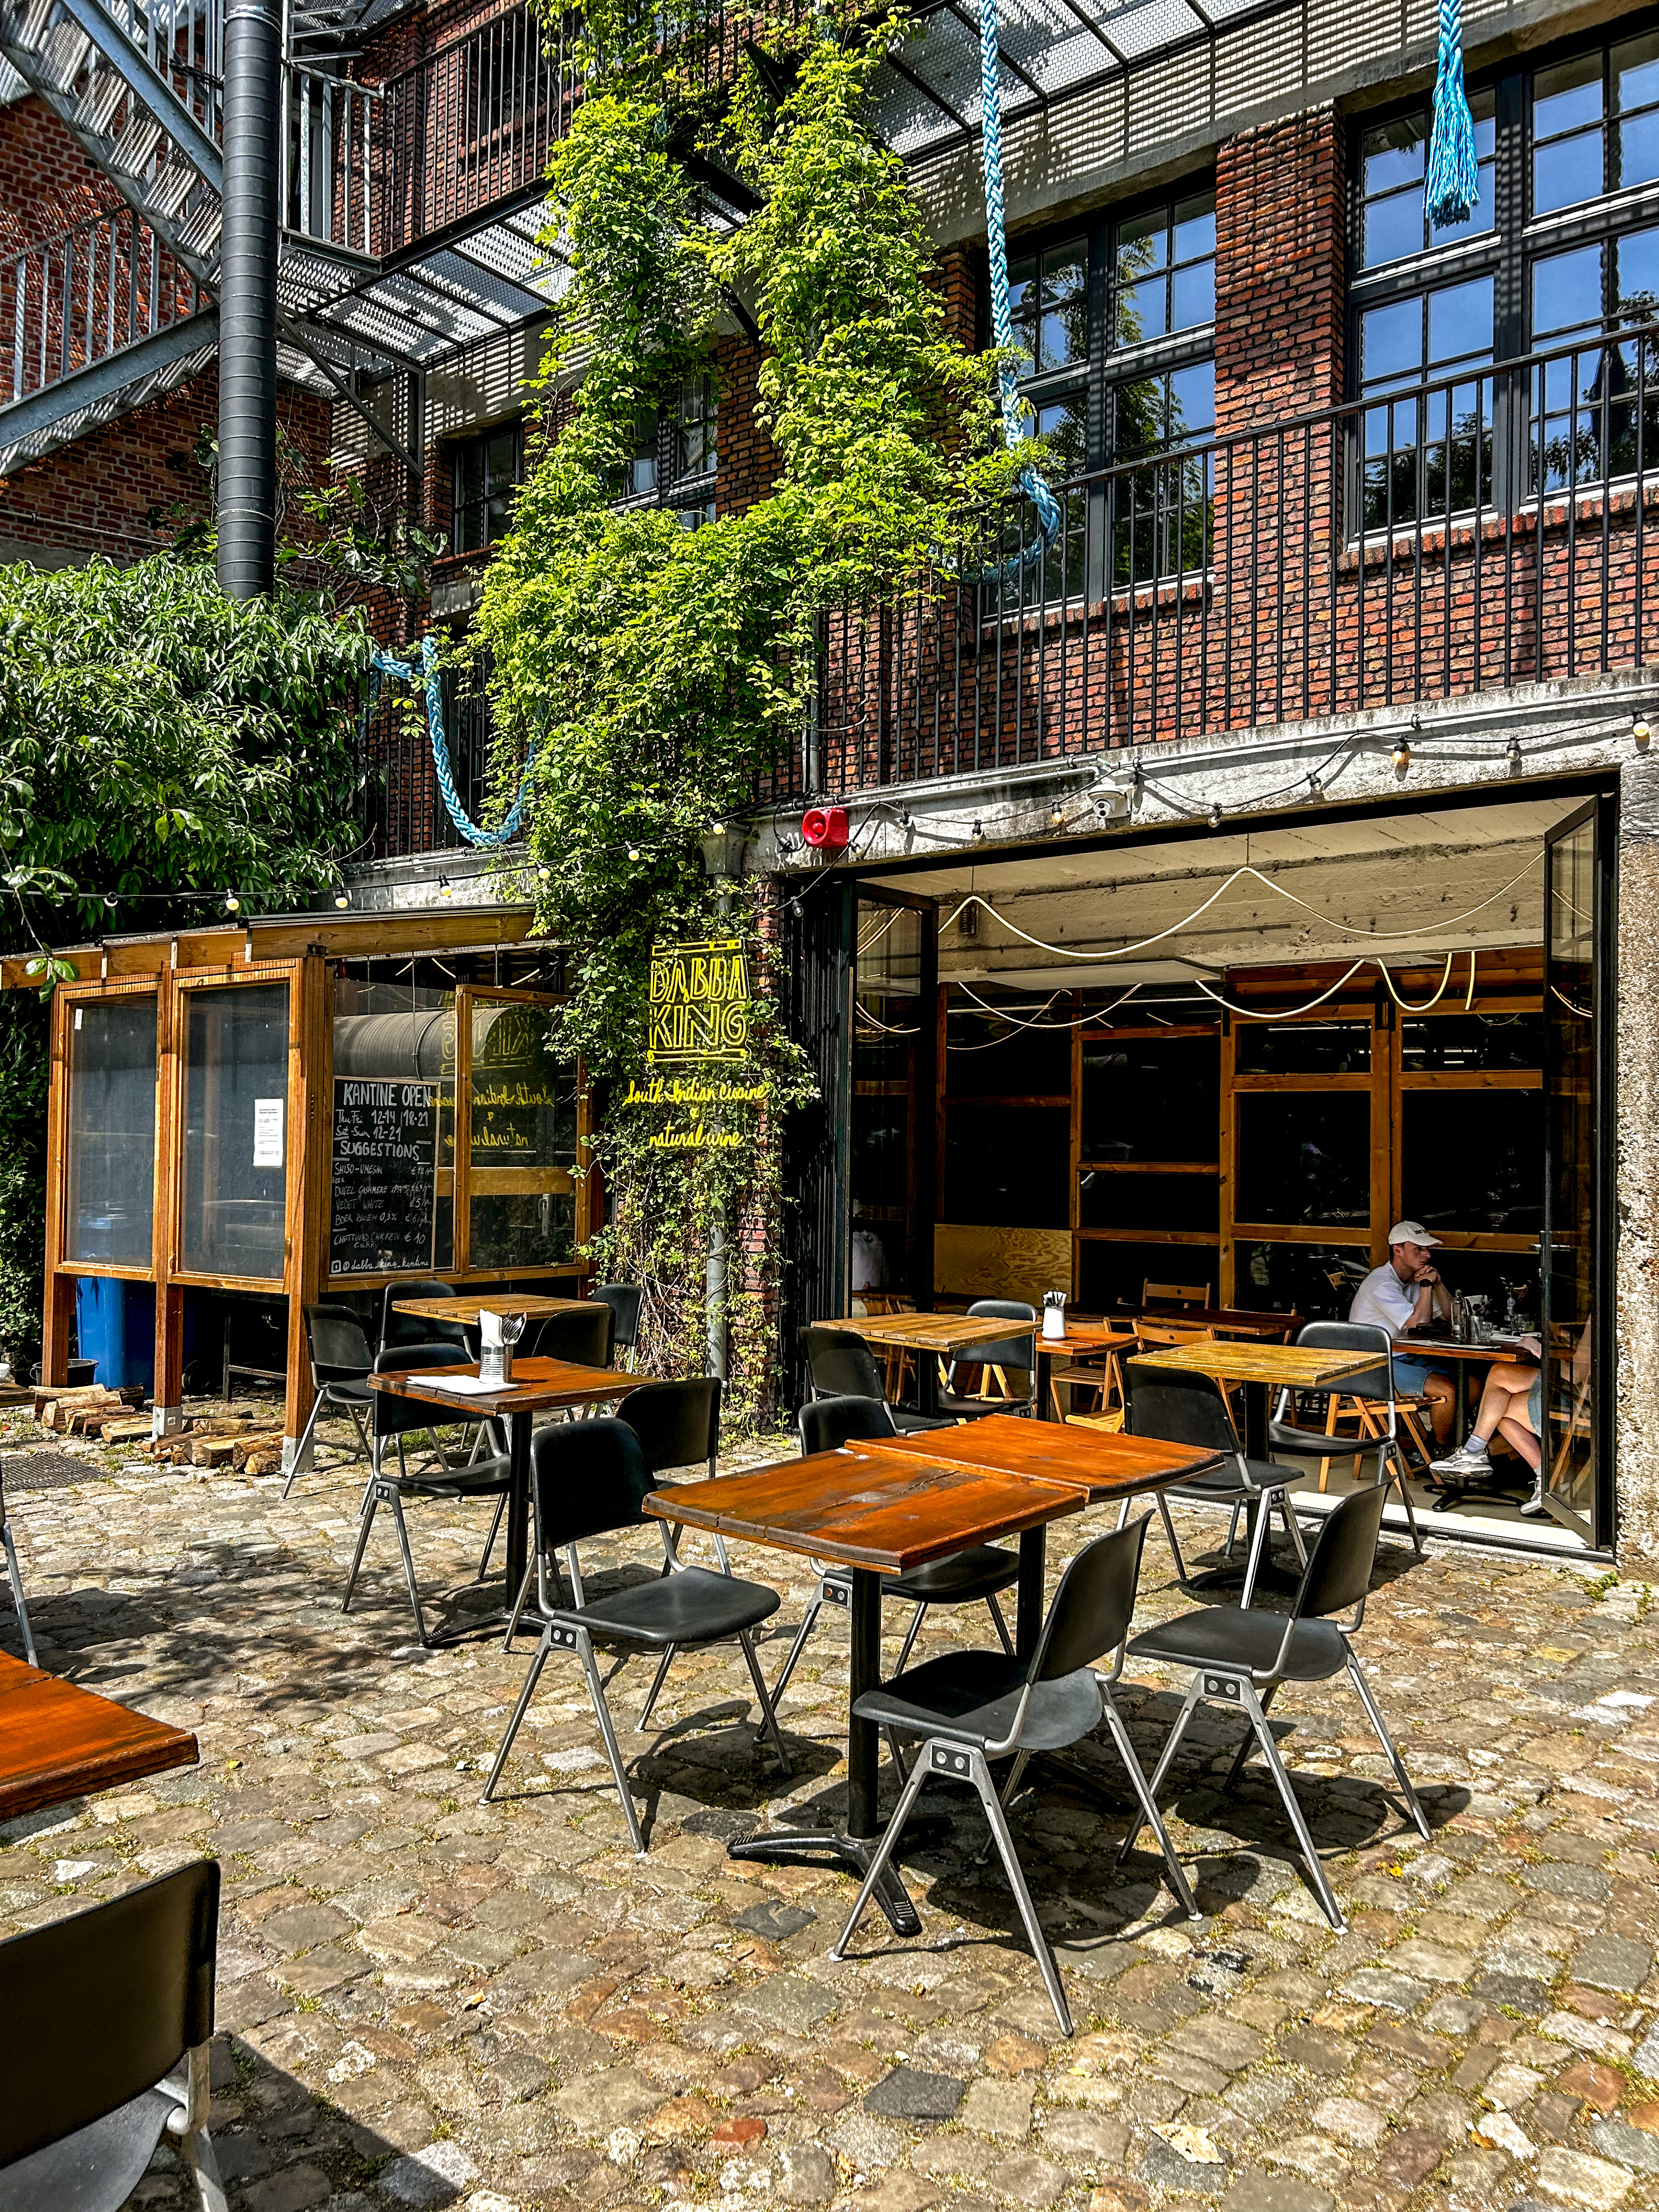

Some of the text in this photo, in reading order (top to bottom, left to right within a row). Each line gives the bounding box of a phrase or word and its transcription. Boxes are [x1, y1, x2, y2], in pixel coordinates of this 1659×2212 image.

[650, 955, 748, 1003] DABBA
[650, 1001, 748, 1049] KING
[343, 1083, 431, 1108] KANTINE OPEN
[623, 1077, 663, 1107] South
[664, 1076, 716, 1104] Indian
[371, 1109, 396, 1125] 12-14
[373, 1125, 401, 1142] 12-21
[649, 1120, 744, 1148] natural wine
[340, 1140, 419, 1161] SUGGESTIONS
[335, 1186, 356, 1197] DUVEL
[358, 1185, 388, 1194] CASHMERE
[363, 1199, 385, 1210] WHITE
[370, 1232, 400, 1241] CHICKEN
[354, 1242, 379, 1252] CURRY
